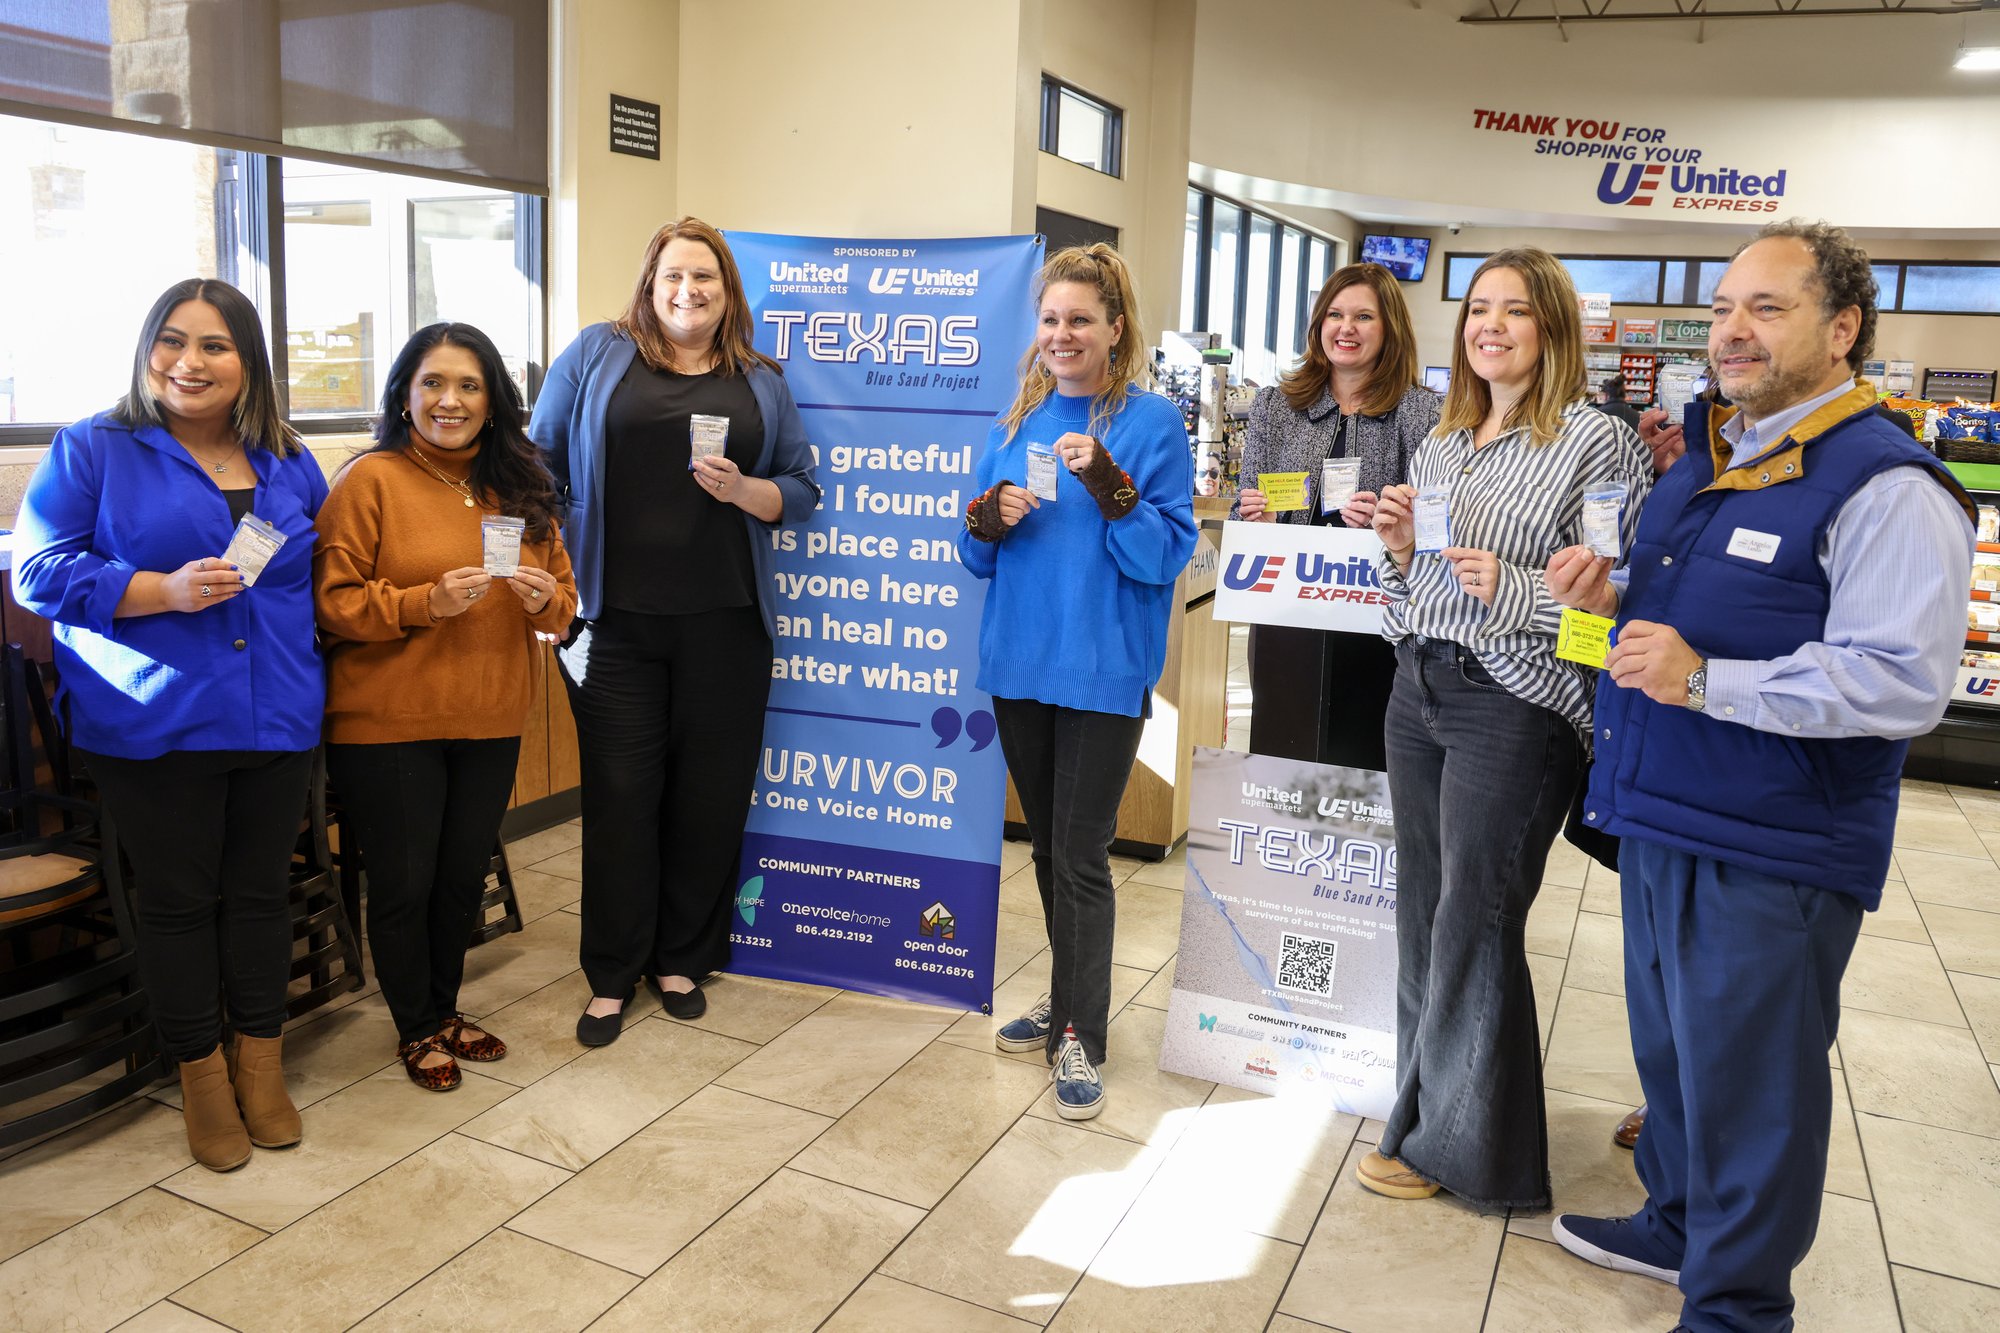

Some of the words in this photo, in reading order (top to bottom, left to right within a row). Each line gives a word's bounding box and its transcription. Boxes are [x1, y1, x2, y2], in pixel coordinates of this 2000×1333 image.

[1473, 109, 1560, 136] THANK
[1565, 118, 1620, 140] YOU
[1622, 127, 1666, 144] FOR
[1534, 139, 1637, 161] SHOPPING
[1644, 147, 1702, 164] YOUR
[1671, 165, 1787, 197] United
[1672, 197, 1779, 212] EXPRESS
[833, 247, 899, 257] SPONSORED
[902, 248, 916, 258] BY
[770, 262, 849, 284] United
[912, 268, 979, 287] United
[770, 284, 848, 295] supermarkets
[913, 287, 976, 296] EXPRESS
[762, 310, 980, 367] TEXAS
[1678, 322, 1710, 338] (ope
[865, 370, 892, 387] Blue
[897, 372, 928, 388] Sand
[933, 374, 980, 391] Project
[830, 444, 972, 474] grateful
[835, 484, 844, 512] I
[856, 484, 960, 518] found
[772, 529, 797, 551] is
[807, 526, 899, 558] place
[1296, 552, 1379, 588] Unit
[774, 572, 870, 600] nyone
[880, 574, 958, 607] here
[1298, 586, 1393, 606] EXPRES
[776, 615, 812, 638] an
[822, 612, 893, 646] heal
[903, 626, 948, 650] no
[771, 654, 852, 685] atter
[862, 662, 959, 696] what!
[764, 748, 958, 804] URVIVOR
[766, 791, 809, 812] One
[817, 797, 878, 821] Voice
[886, 806, 953, 830] Home
[1241, 798, 1302, 813] supermarkets
[1352, 816, 1394, 826] EXPRES
[1242, 782, 1302, 804] United
[1352, 800, 1393, 818] Unite
[758, 857, 844, 879] COMMUNITY
[846, 869, 921, 890] PARTNERS
[744, 897, 765, 907] HOPE
[1211, 892, 1240, 905] Texas,
[1242, 896, 1256, 907] it's
[1259, 900, 1281, 911] time
[1283, 904, 1293, 913] to
[1295, 906, 1313, 917] join
[1316, 909, 1347, 922] voices
[1350, 916, 1360, 925] as
[1362, 919, 1377, 928] we
[1379, 922, 1396, 932] sup
[1313, 884, 1339, 900] Blue
[1344, 890, 1371, 906] Sand
[1376, 895, 1397, 913] Pro
[796, 924, 873, 944] 806.429.2192
[1245, 910, 1289, 923] survivors
[1291, 918, 1302, 926] of
[1304, 920, 1320, 929] sex
[1322, 922, 1376, 940] trafficking!
[730, 934, 772, 948] 63.3232
[904, 939, 935, 953] open
[937, 943, 968, 958] door
[895, 958, 975, 979] 806.687.6876
[1262, 988, 1343, 1011] #TXBlueSandProject
[1248, 1013, 1300, 1030] COMMUNITY
[1301, 1024, 1347, 1040] PARTNERS
[1320, 1070, 1365, 1088] MRCCAC
